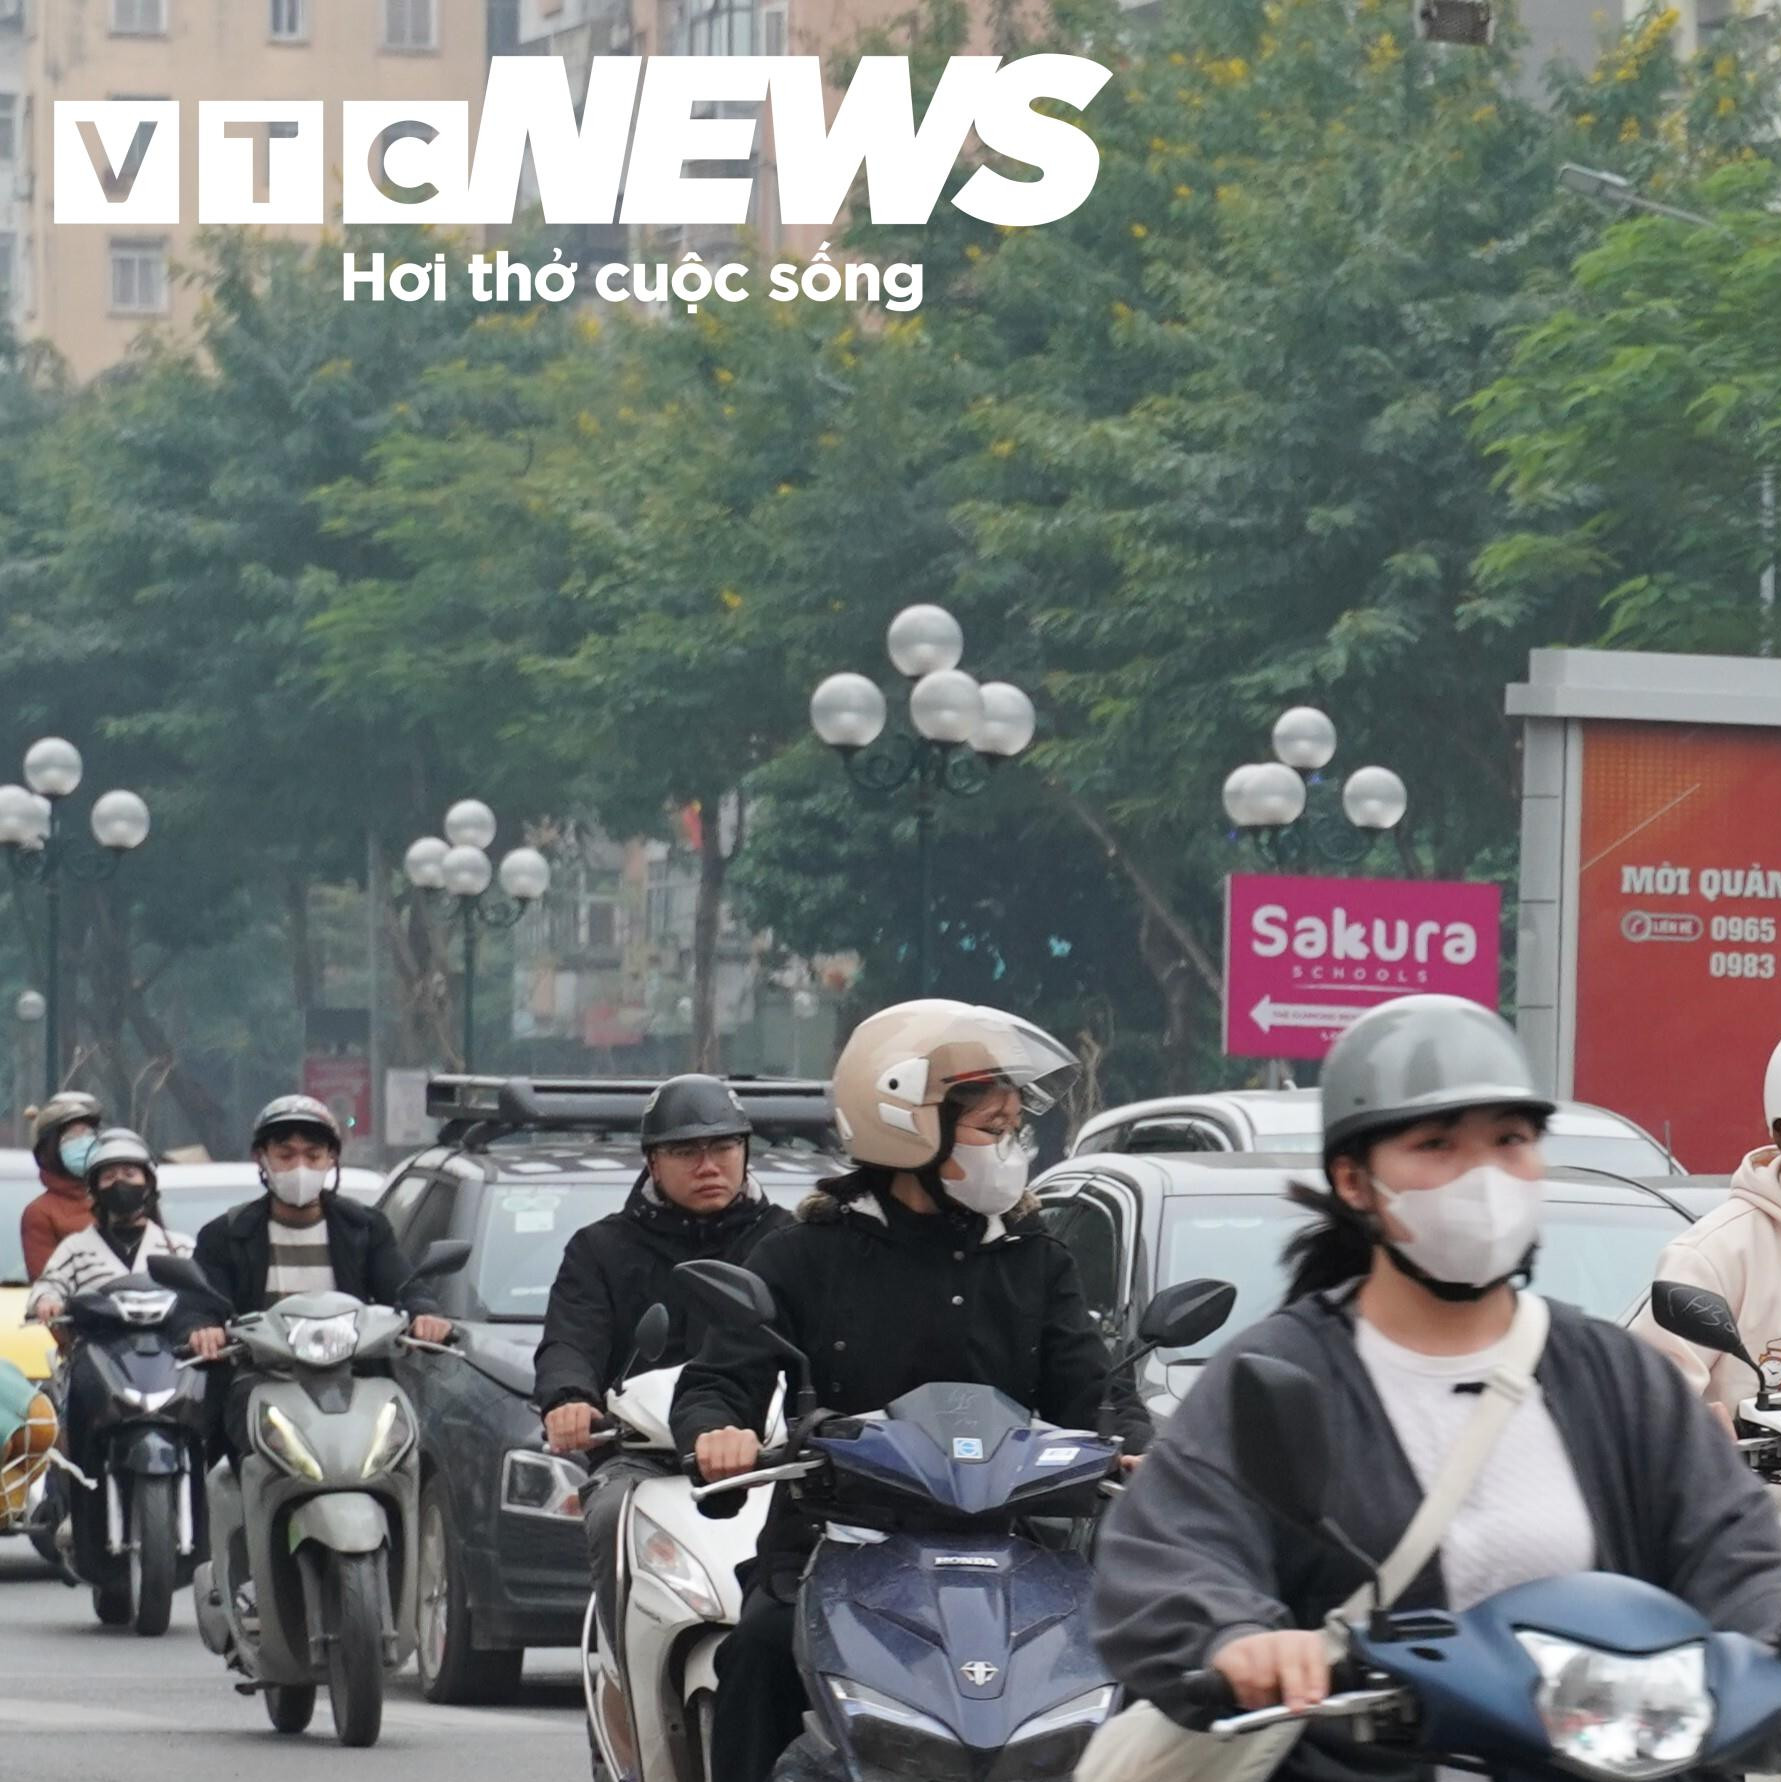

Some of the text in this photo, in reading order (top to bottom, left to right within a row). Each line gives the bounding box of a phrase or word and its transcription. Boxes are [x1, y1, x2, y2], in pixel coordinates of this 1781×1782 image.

[1252, 904, 1477, 965] Sakura
[1711, 916, 1776, 943] 0965
[1292, 965, 1428, 983] SCHOOLS
[1710, 952, 1775, 979] 0983
[934, 1556, 999, 1569] HONDA
